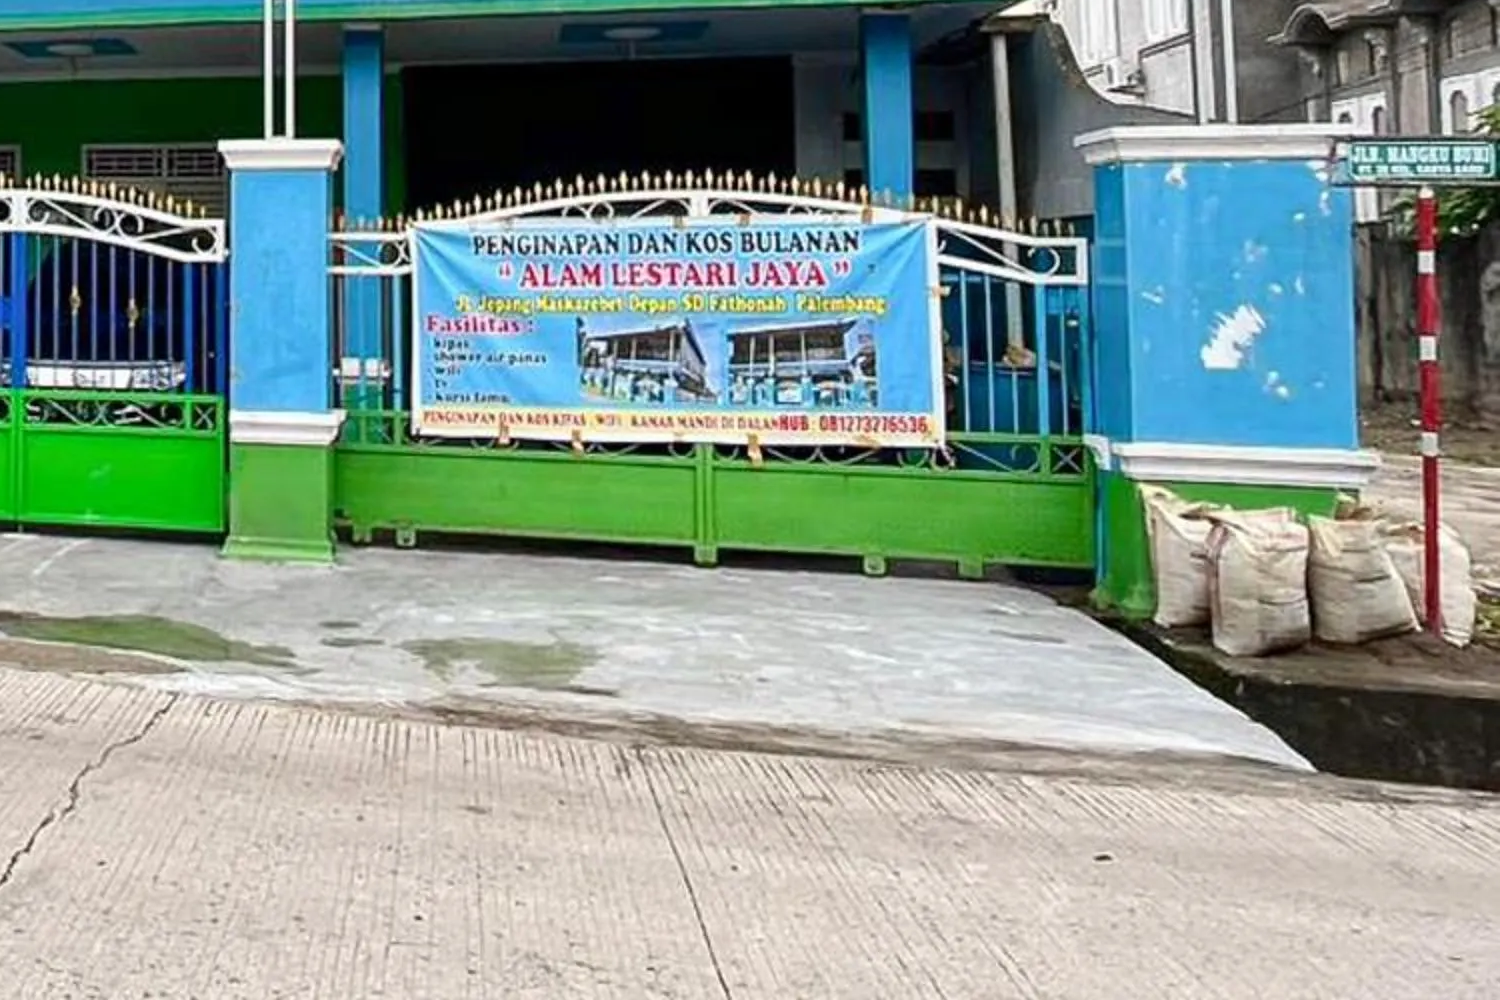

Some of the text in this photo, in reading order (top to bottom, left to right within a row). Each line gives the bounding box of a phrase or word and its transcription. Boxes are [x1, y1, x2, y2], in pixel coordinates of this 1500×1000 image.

[473, 230, 860, 256] PENGINAPAN DAN KOS BULANAN
[520, 262, 601, 287] ALAM
[612, 262, 738, 287] LESTARI
[745, 261, 827, 286] JAYA
[681, 293, 705, 312] SD
[709, 294, 786, 312] Fathonah
[795, 293, 886, 315] Palembang
[427, 315, 521, 333] Fasilitas
[423, 411, 496, 425] PENGINAPAN
